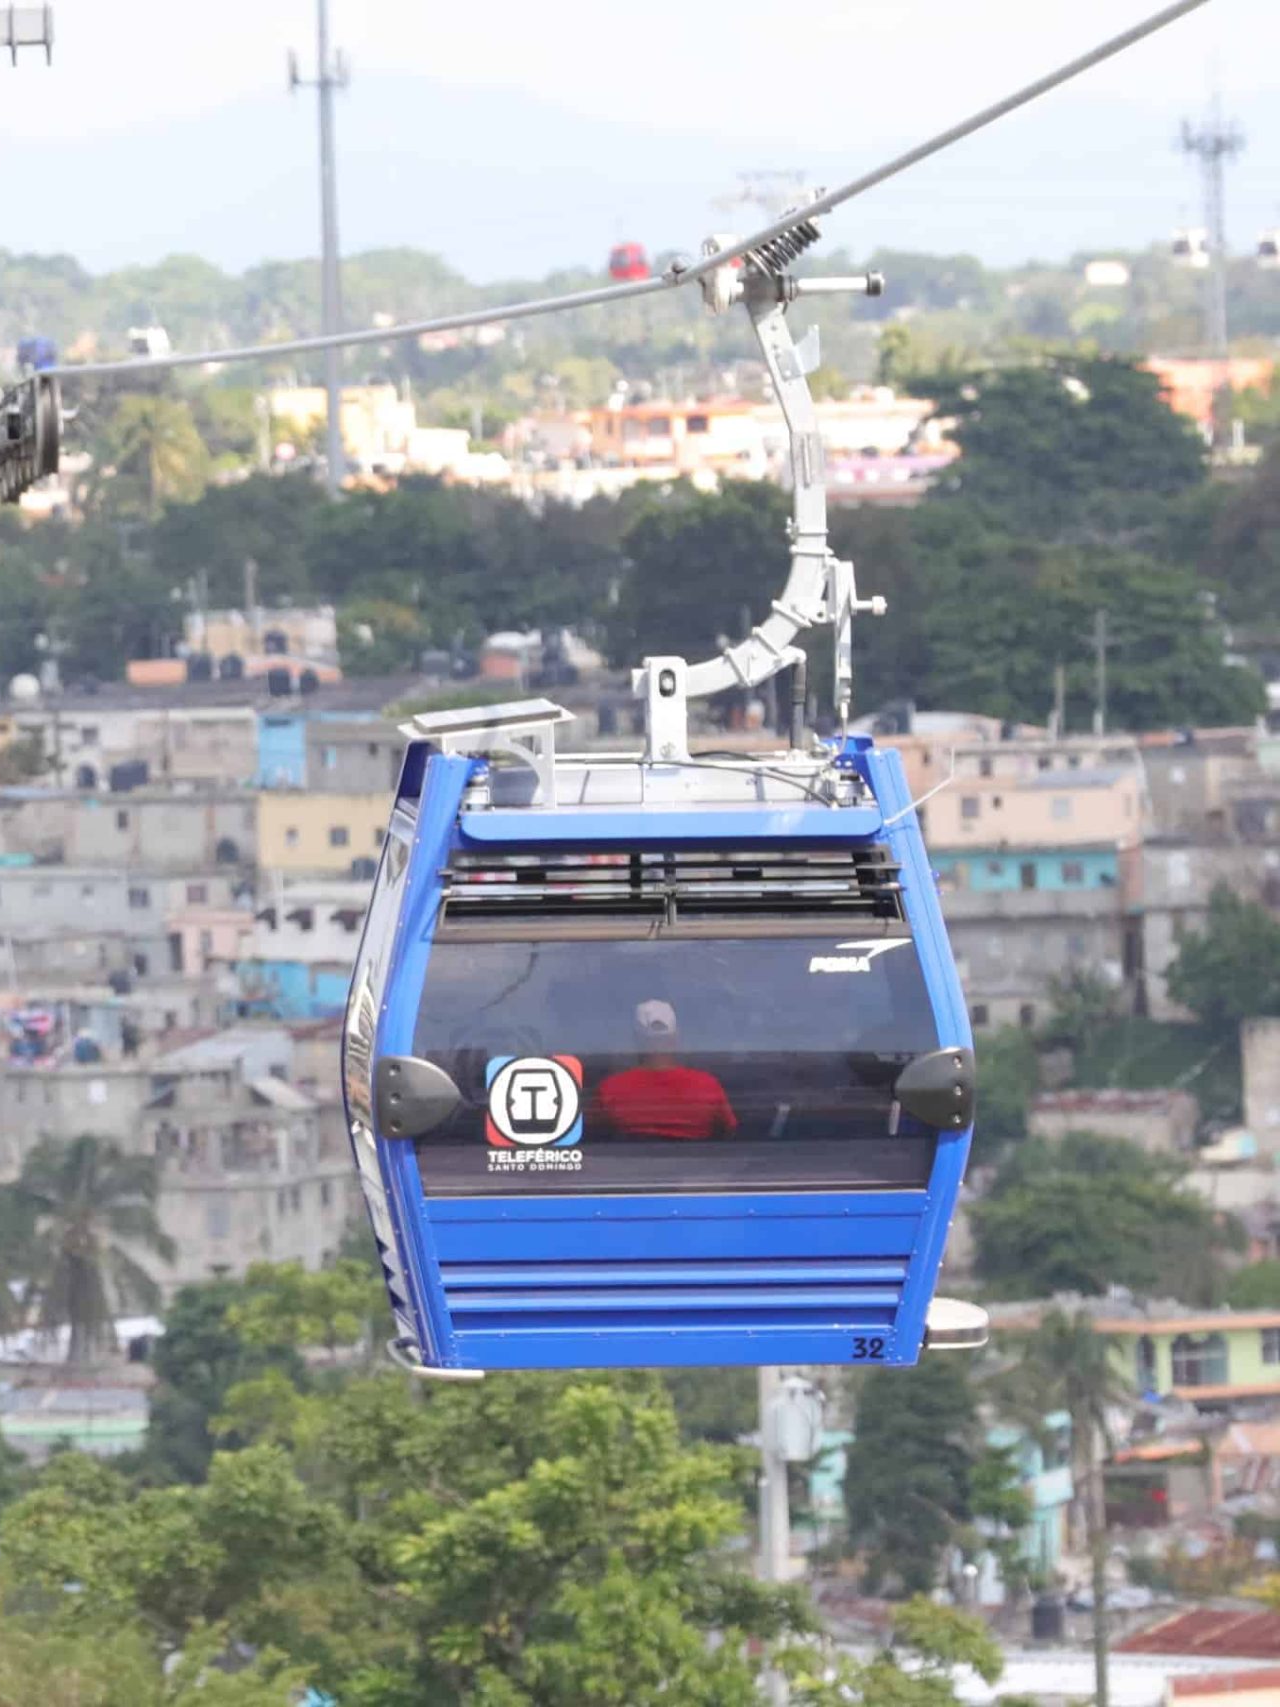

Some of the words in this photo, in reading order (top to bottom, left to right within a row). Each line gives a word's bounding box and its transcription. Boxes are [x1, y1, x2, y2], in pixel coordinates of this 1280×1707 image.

[486, 1147, 583, 1164] TELEFÉRICO
[487, 1162, 525, 1172] SANTO
[851, 1336, 885, 1360] 32
